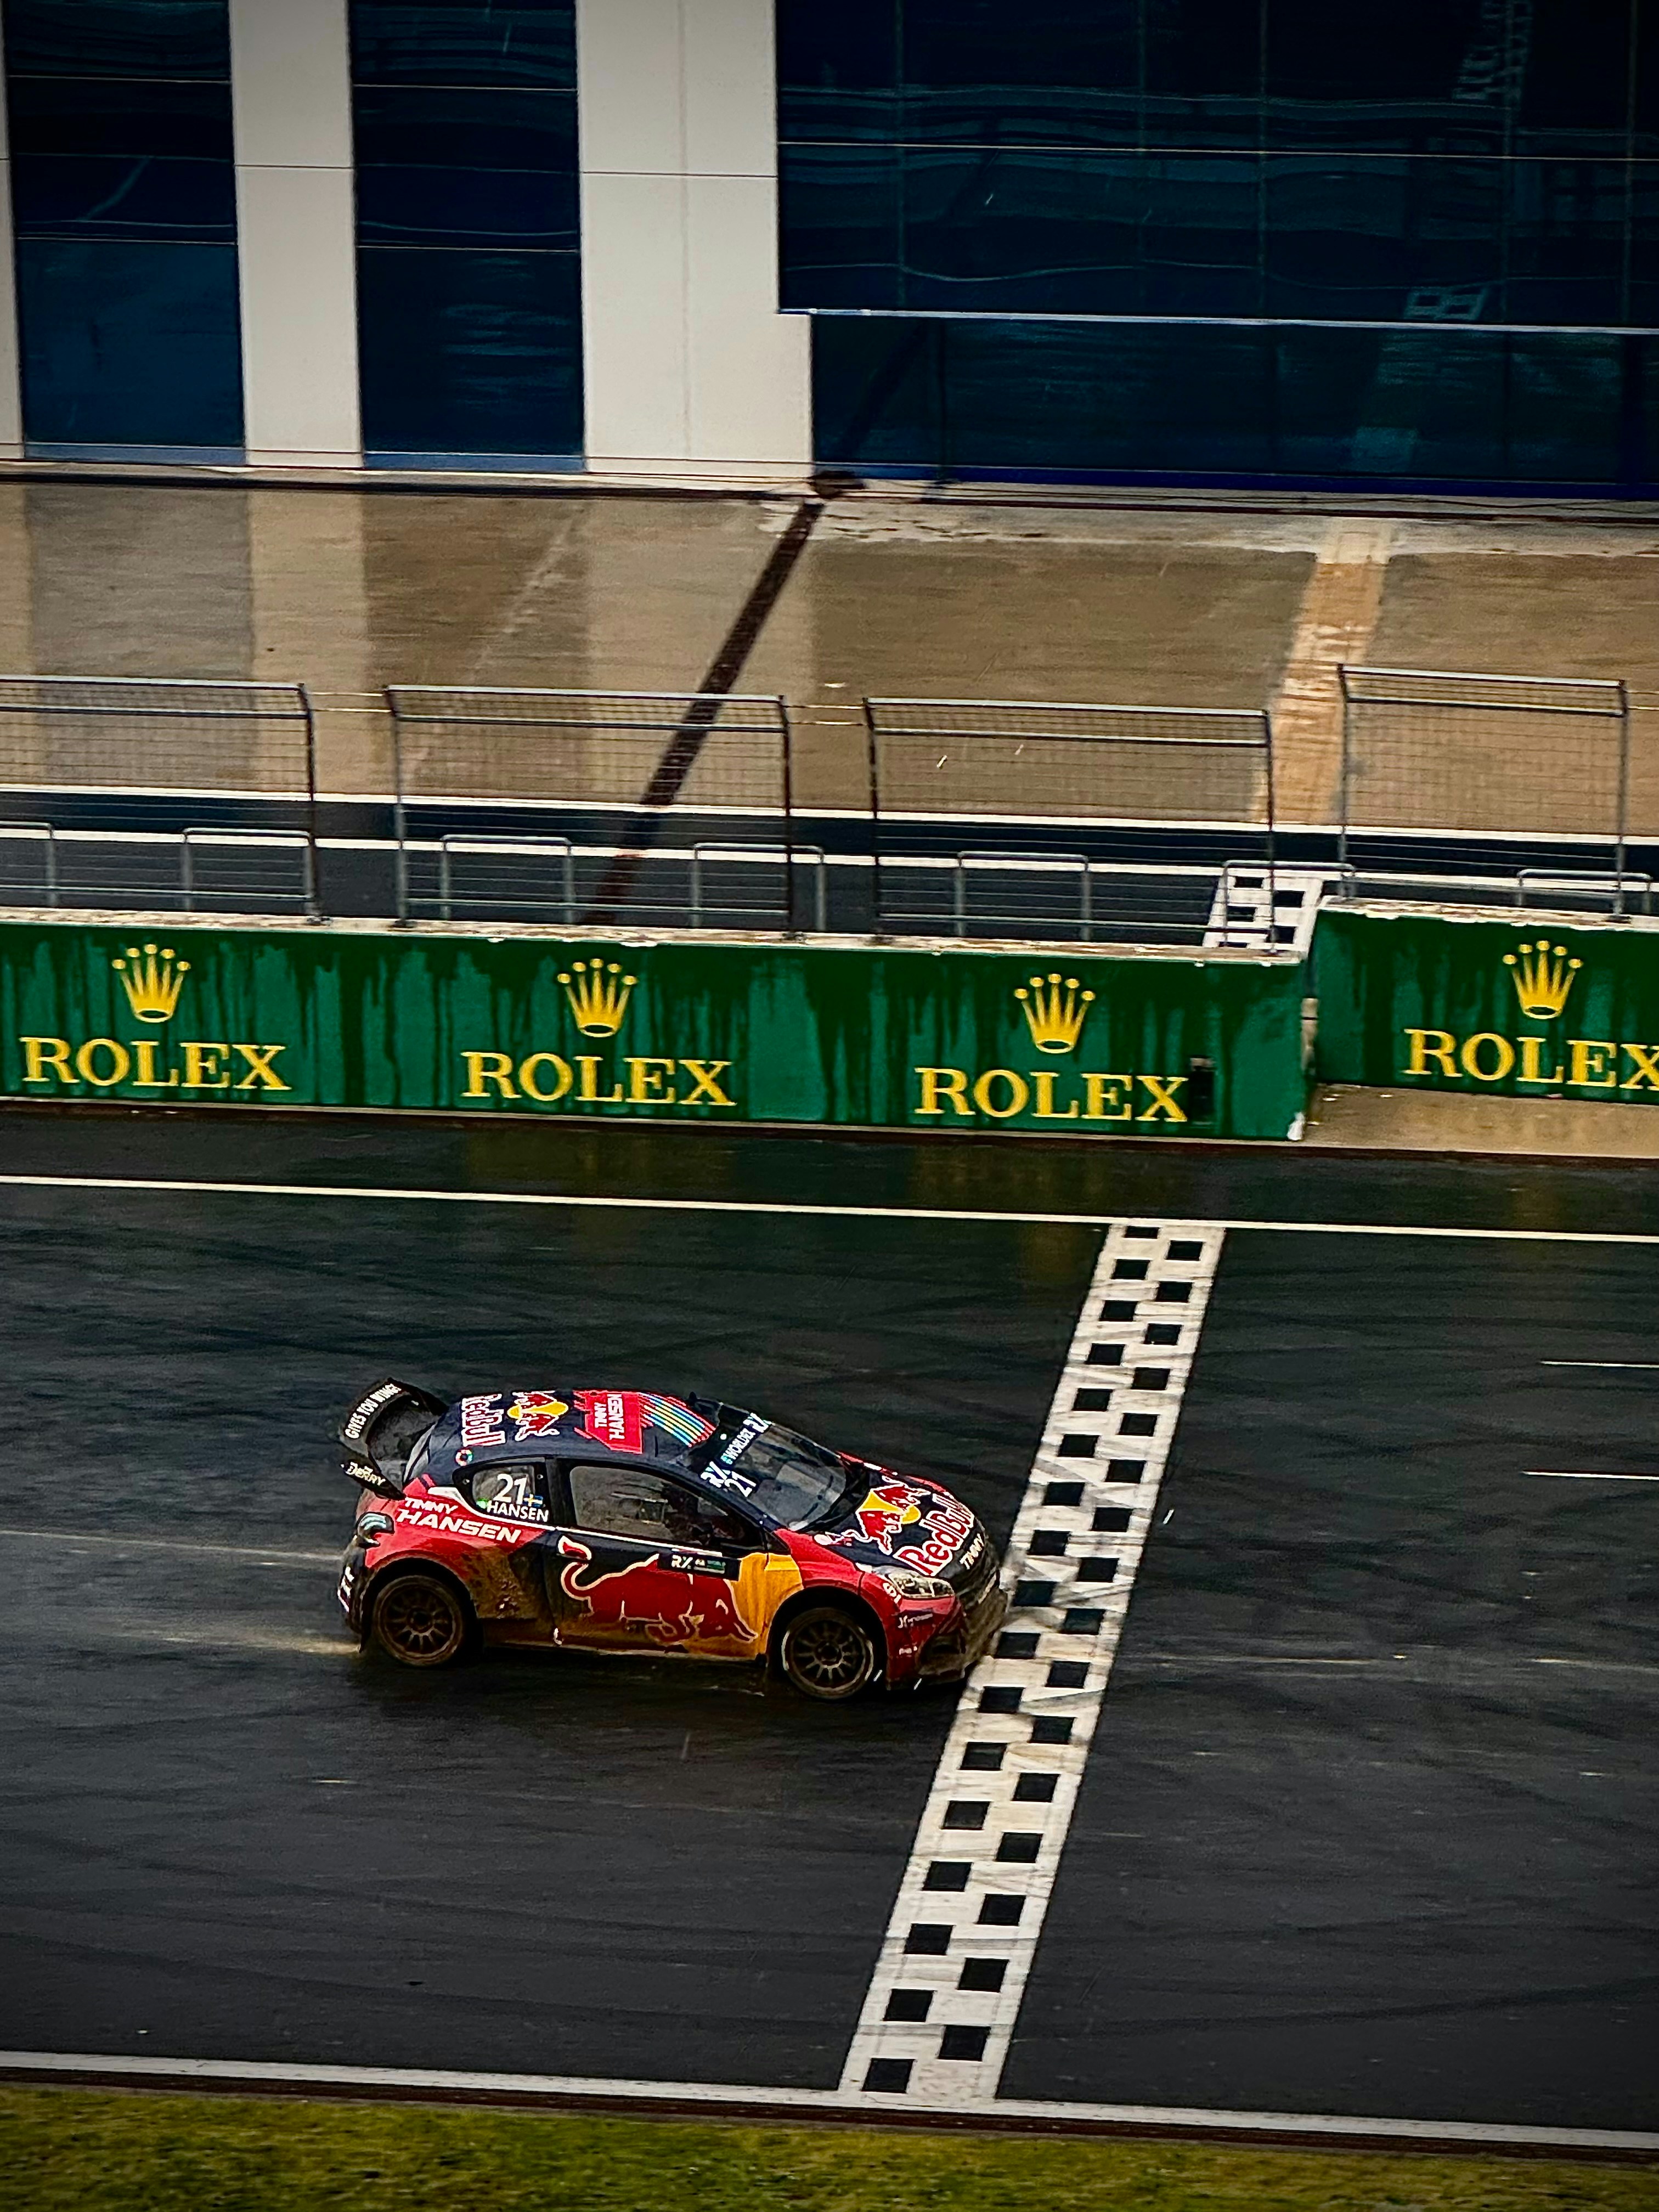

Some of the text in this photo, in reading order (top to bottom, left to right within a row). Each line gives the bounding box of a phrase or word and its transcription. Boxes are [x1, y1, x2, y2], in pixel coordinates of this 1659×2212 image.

[20, 1036, 291, 1090] ROLEX
[1404, 1029, 1659, 1091] ROLEX
[461, 1051, 737, 1107] ROLEX
[914, 1067, 1189, 1123] ROLEX
[357, 1398, 379, 1416] YOU
[607, 1393, 625, 1440] HANSEN
[493, 1473, 527, 1505] 21
[724, 1471, 757, 1498] 21
[405, 1497, 459, 1515] TIMMY
[487, 1500, 549, 1522] HANSEN
[396, 1508, 522, 1544] HANSEN
[671, 1554, 693, 1570] RX
